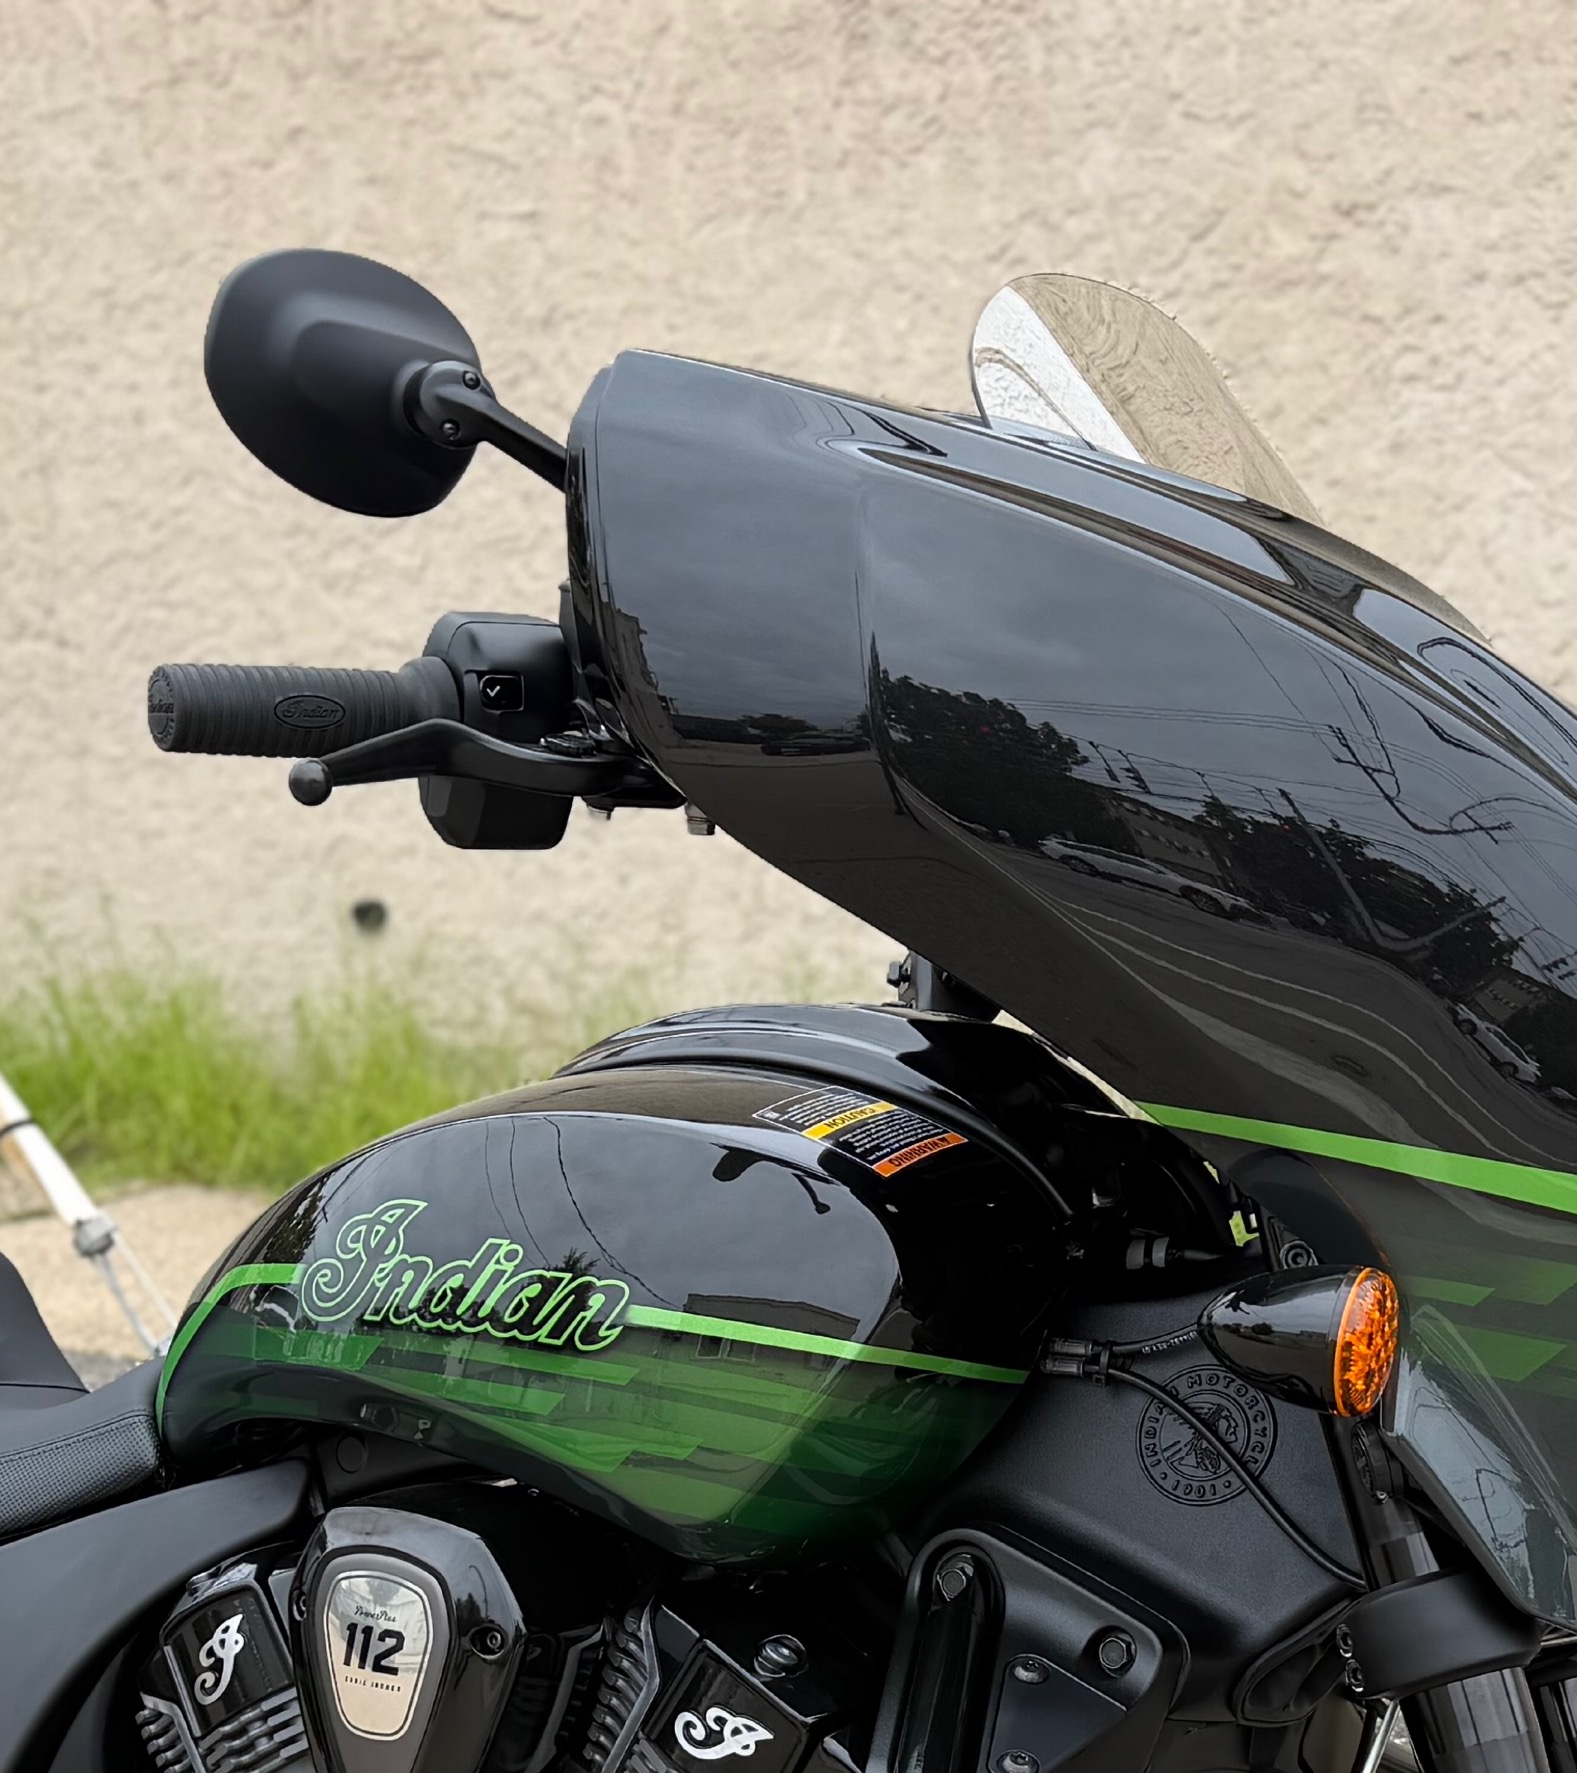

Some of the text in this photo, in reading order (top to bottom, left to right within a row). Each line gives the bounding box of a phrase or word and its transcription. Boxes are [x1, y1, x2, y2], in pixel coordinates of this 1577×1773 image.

[282, 700, 341, 720] Indian
[822, 1107, 875, 1129] CAUTION
[888, 1138, 941, 1168] WARNING
[300, 1197, 630, 1352] Indian
[1144, 1387, 1179, 1467] INDIA
[343, 1622, 405, 1676] 112
